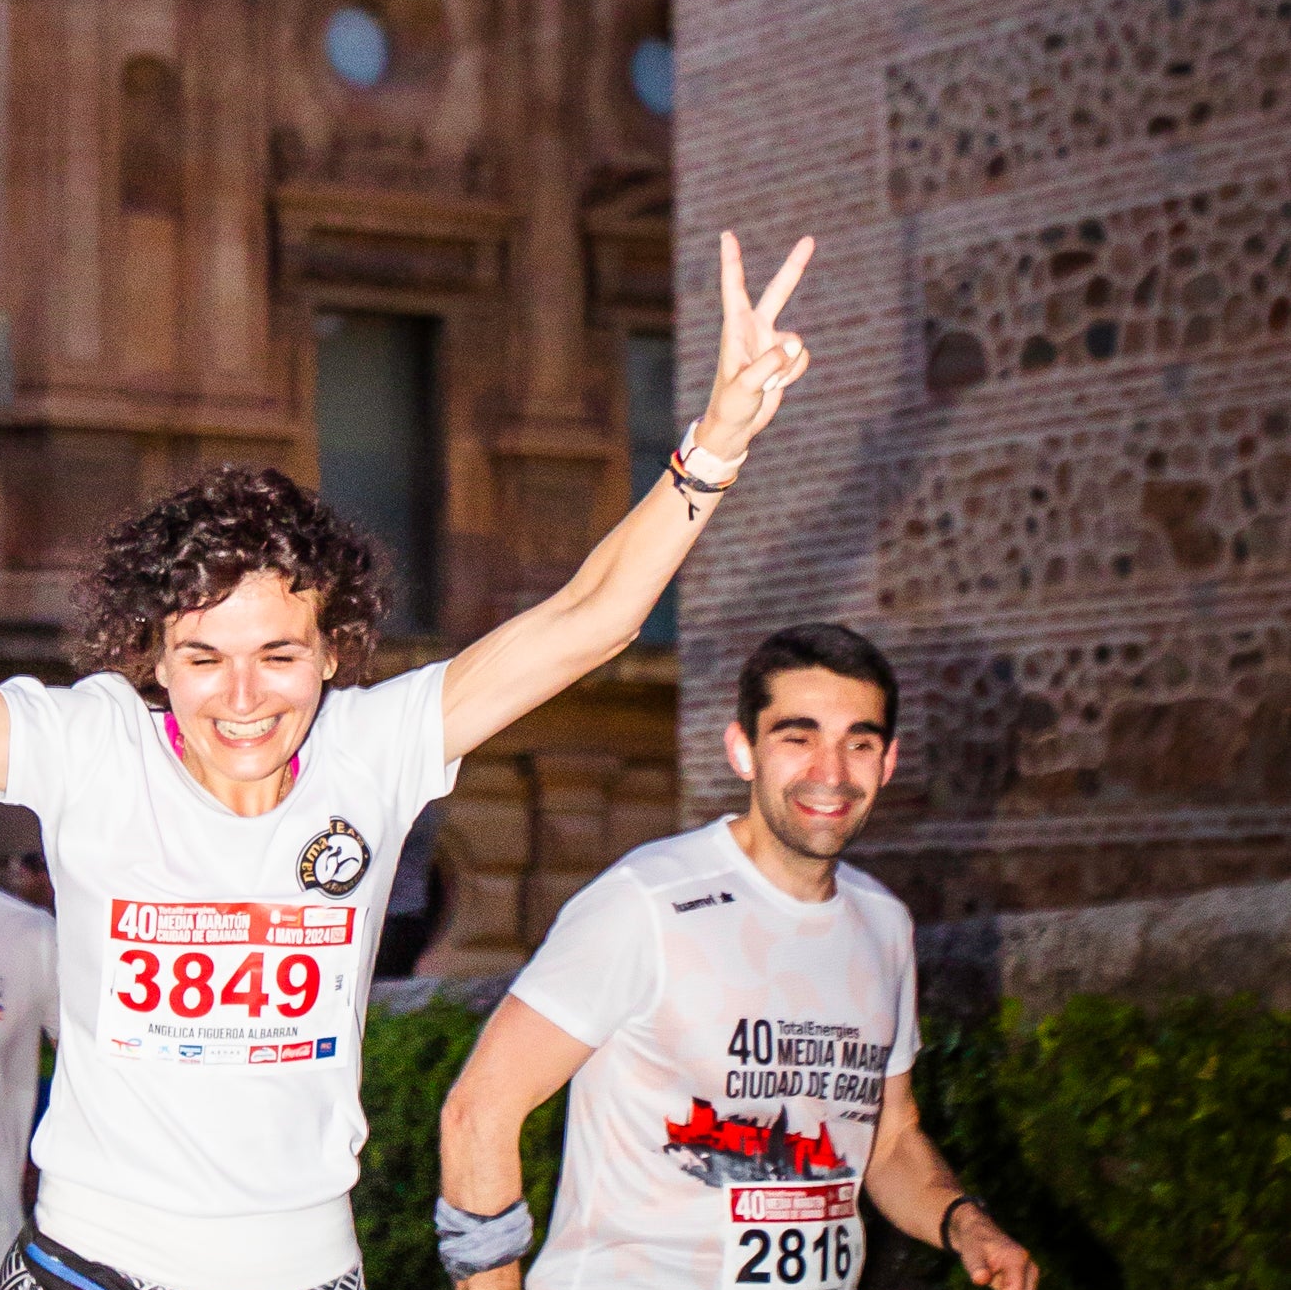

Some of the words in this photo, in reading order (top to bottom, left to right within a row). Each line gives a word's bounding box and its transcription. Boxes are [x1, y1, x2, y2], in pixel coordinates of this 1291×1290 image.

[117, 903, 158, 941] 40
[156, 929, 191, 942] CIUDAD
[192, 930, 204, 942] DE
[205, 930, 249, 942] GRANADA
[158, 914, 194, 930] MEDIA
[195, 912, 251, 930] MARATÓN
[266, 927, 274, 943] 4
[275, 928, 303, 944] MAYO
[304, 928, 330, 944] 2024
[117, 949, 321, 1018] 3849
[728, 1018, 773, 1065] 40
[777, 1020, 860, 1041] TotalEnergies
[777, 1038, 835, 1067] MEDIA
[726, 1070, 802, 1099] CIUDAD
[806, 1072, 831, 1100] DE
[735, 1190, 766, 1220] 40
[735, 1224, 851, 1284] 2816
